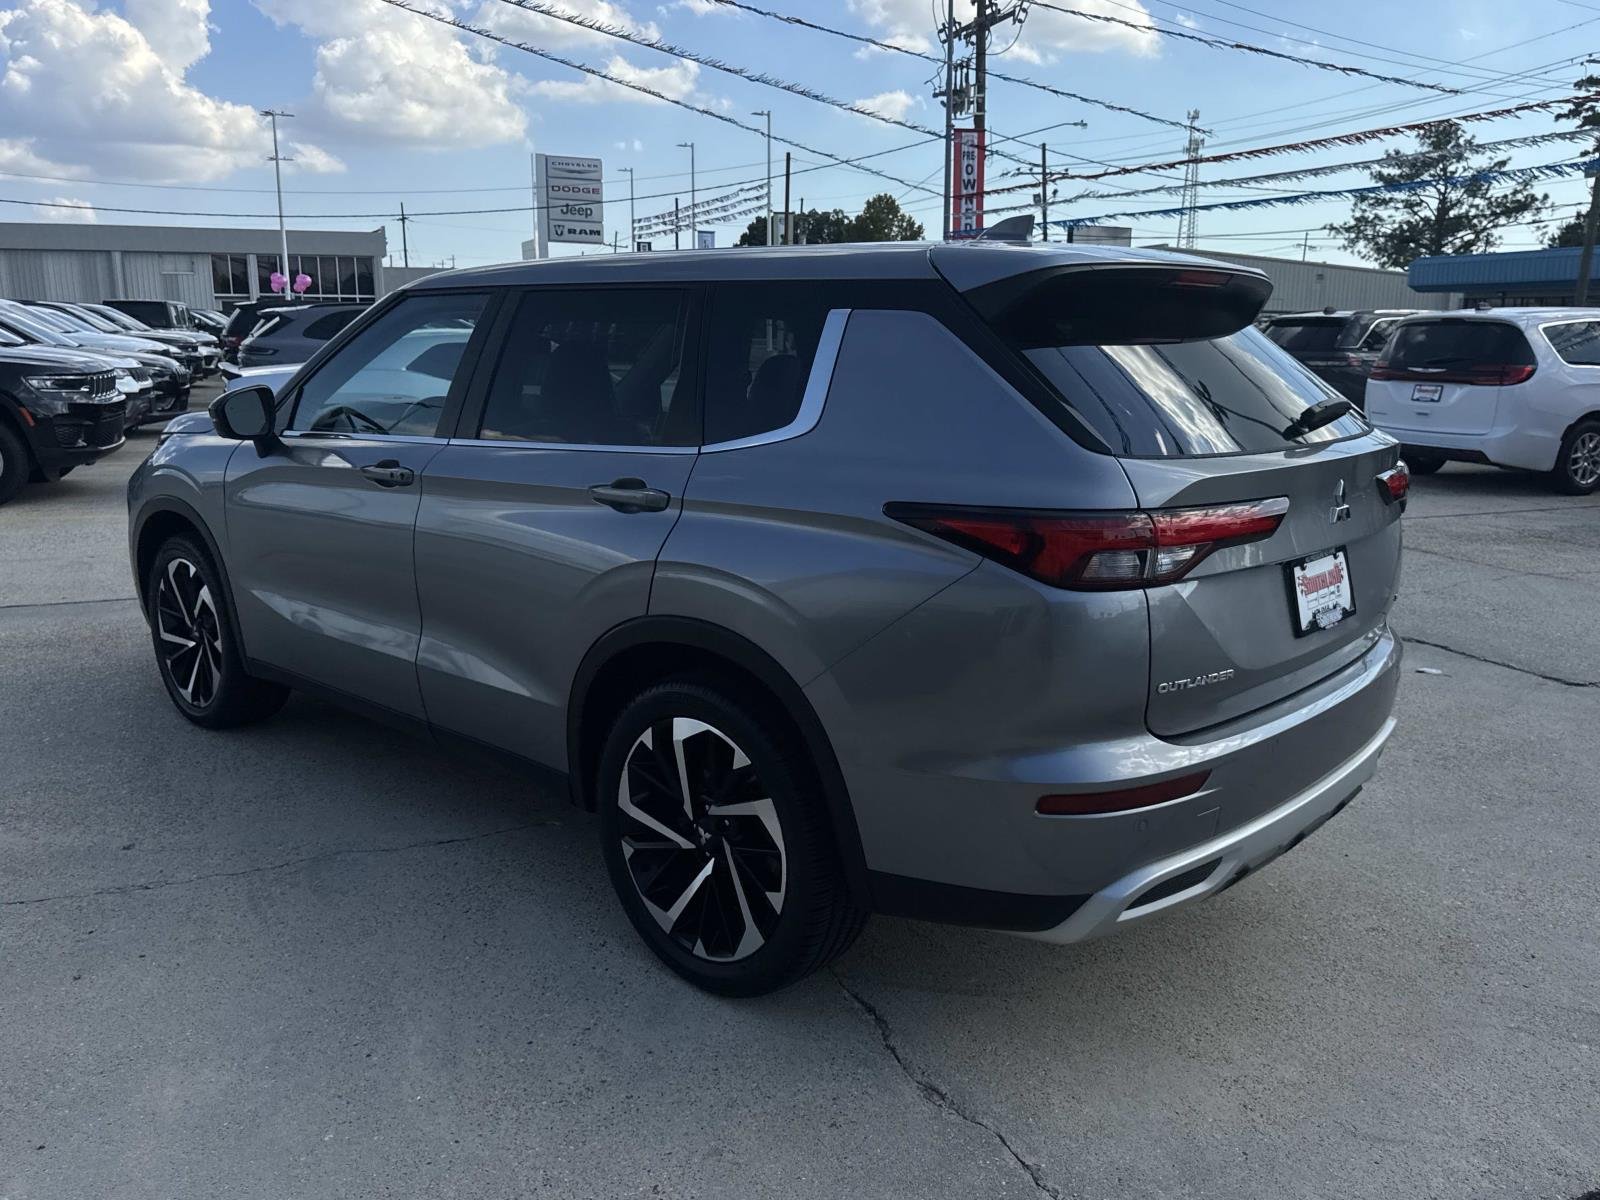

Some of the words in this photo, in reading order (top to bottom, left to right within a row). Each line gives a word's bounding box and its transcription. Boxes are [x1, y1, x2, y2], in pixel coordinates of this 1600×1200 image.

[551, 185, 600, 195] DODGE
[560, 203, 593, 218] Jeep
[567, 228, 601, 236] RAM
[1157, 668, 1235, 694] OUTLANDER
